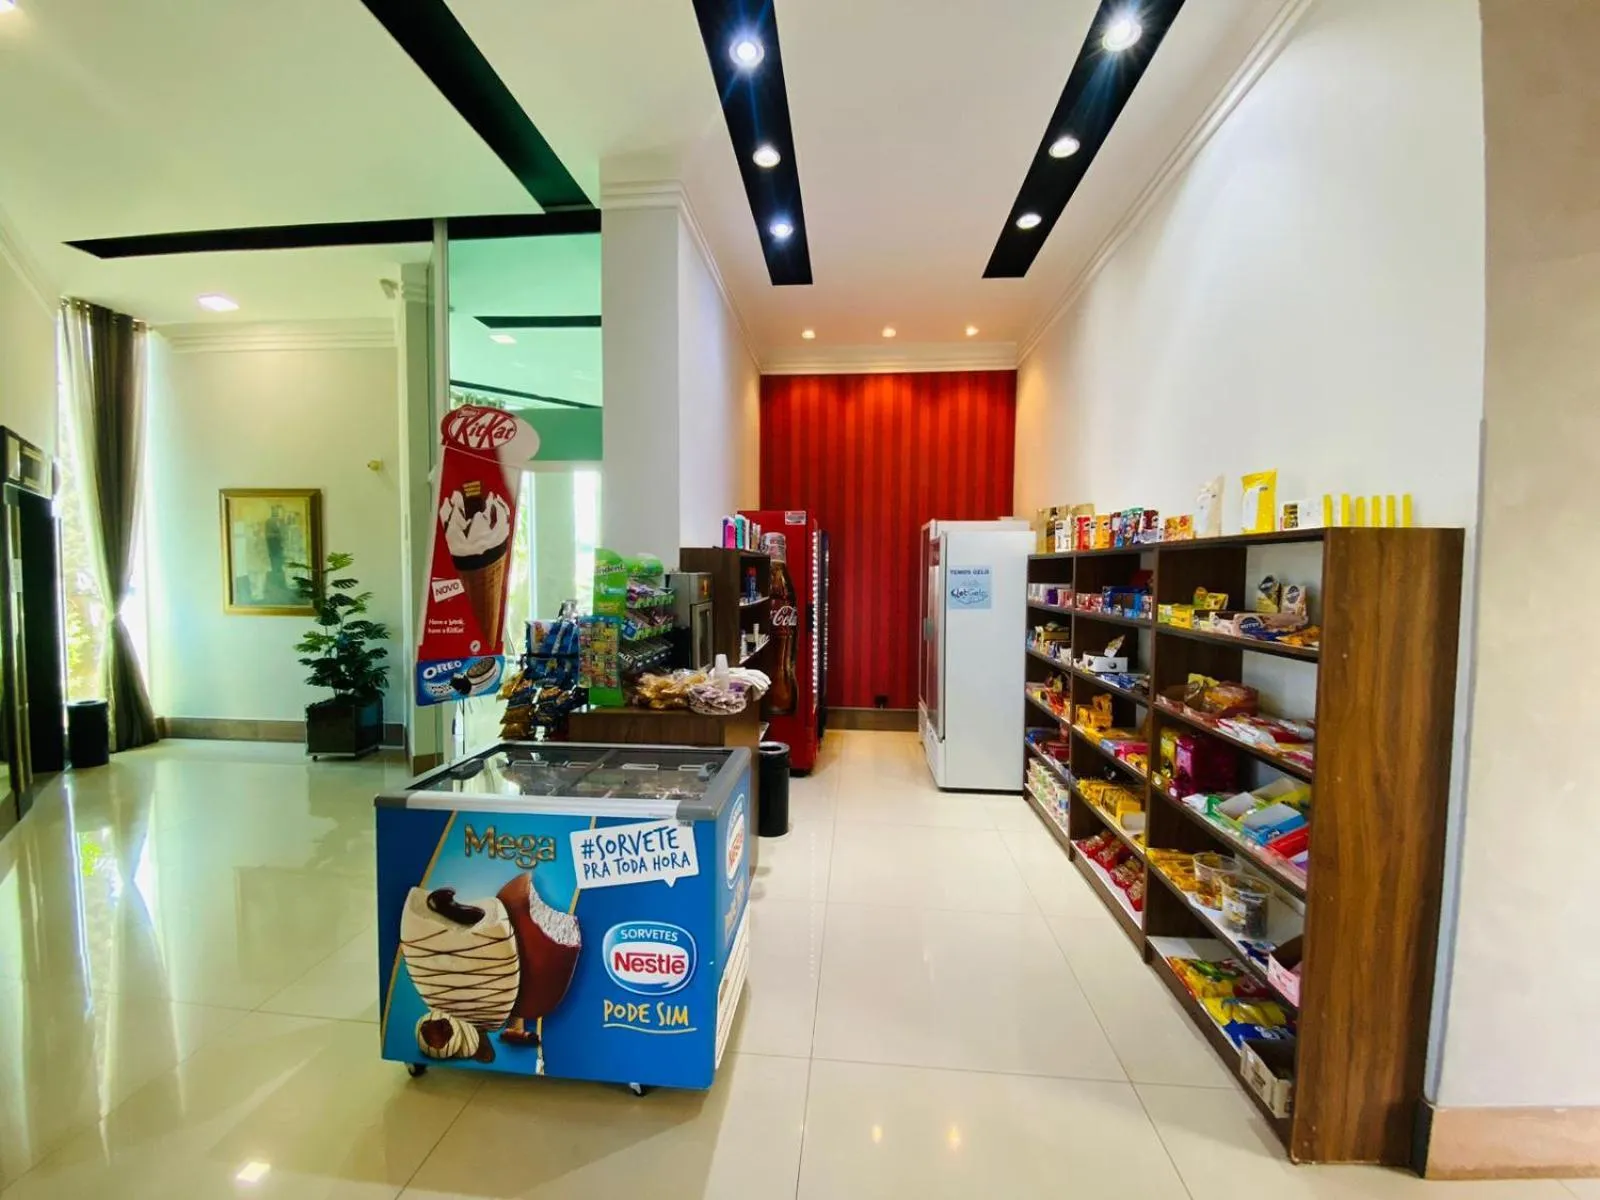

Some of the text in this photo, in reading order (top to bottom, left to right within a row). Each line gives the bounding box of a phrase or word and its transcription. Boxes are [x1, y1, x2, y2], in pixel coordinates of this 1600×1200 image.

[454, 412, 515, 448] KitKat
[435, 582, 460, 597] NOVO
[422, 661, 462, 680] OREO
[464, 823, 557, 869] Mega
[581, 826, 680, 860] #SORVETE
[583, 852, 691, 880] PRA TODA HORA
[620, 927, 678, 943] SORVETES
[614, 951, 685, 976] Nestlé
[603, 999, 689, 1027] PODE SIM
